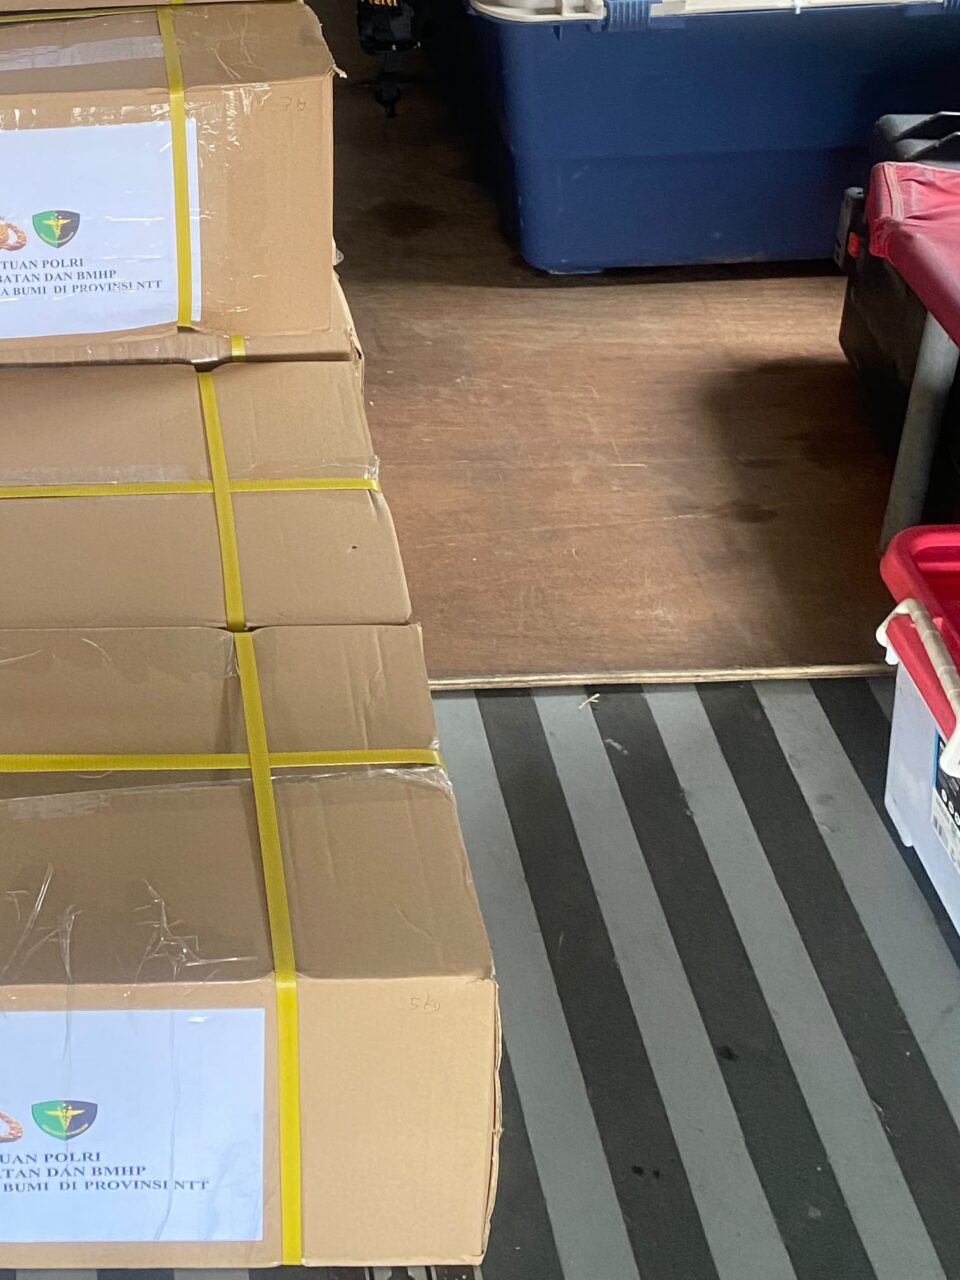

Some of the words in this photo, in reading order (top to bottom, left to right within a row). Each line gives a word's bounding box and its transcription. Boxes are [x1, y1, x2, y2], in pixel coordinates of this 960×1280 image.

[42, 257, 84, 269] POLRI
[45, 270, 73, 282] DAN
[76, 269, 117, 280] BMHP
[13, 285, 47, 296] BUMI
[53, 284, 67, 295] DI
[71, 281, 134, 294] PROVINSI
[136, 279, 163, 290] NTT
[44, 1151, 101, 1163] POLRI
[47, 1166, 86, 1178] DAN
[91, 1165, 147, 1177] BMHP
[3, 1181, 49, 1193] BUMI
[59, 1181, 77, 1191] DI
[84, 1180, 168, 1191] PROVINSI
[173, 1179, 210, 1191] NTT
